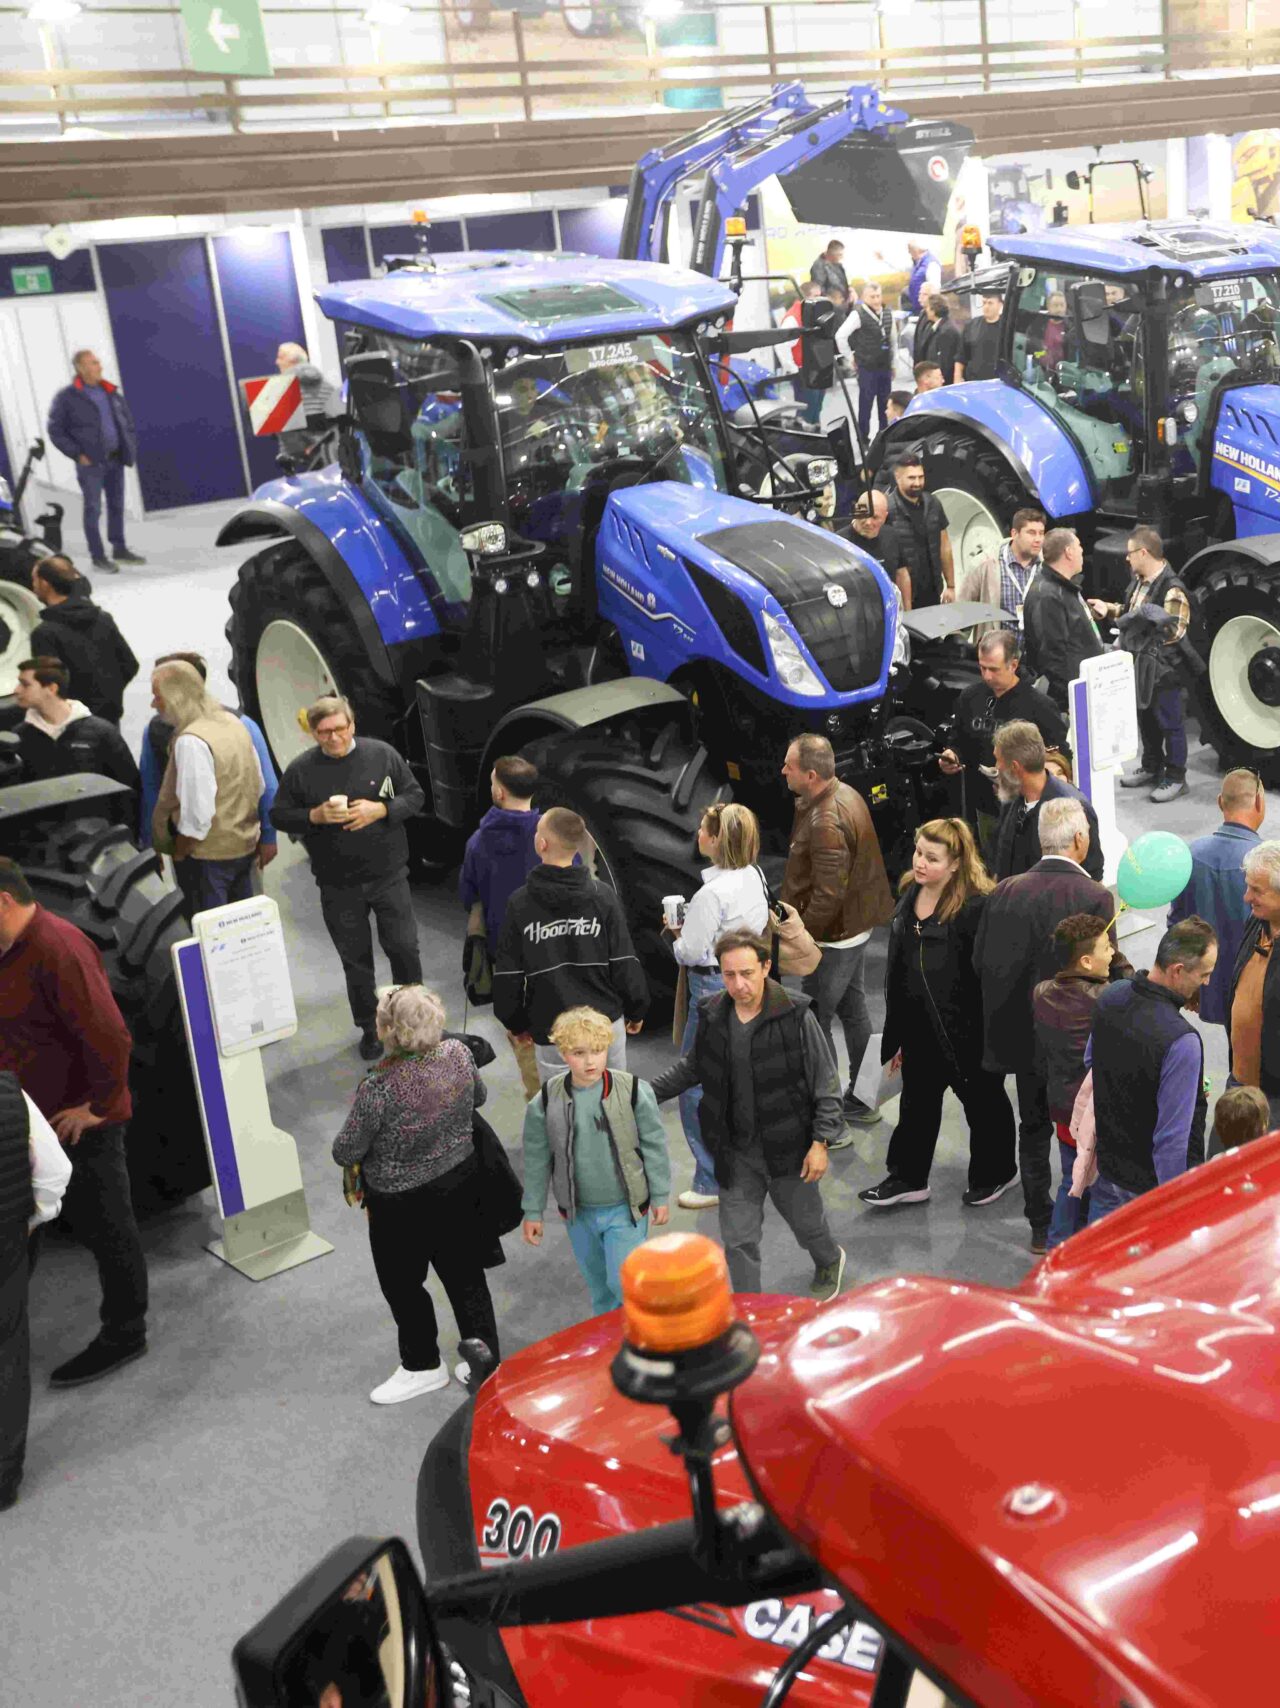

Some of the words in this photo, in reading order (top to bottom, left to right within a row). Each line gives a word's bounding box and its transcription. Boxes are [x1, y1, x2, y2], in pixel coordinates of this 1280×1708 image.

[1211, 284, 1241, 298] T7.210
[588, 342, 633, 361] T7.245
[1215, 440, 1240, 462] NEW
[482, 1497, 562, 1561] 300
